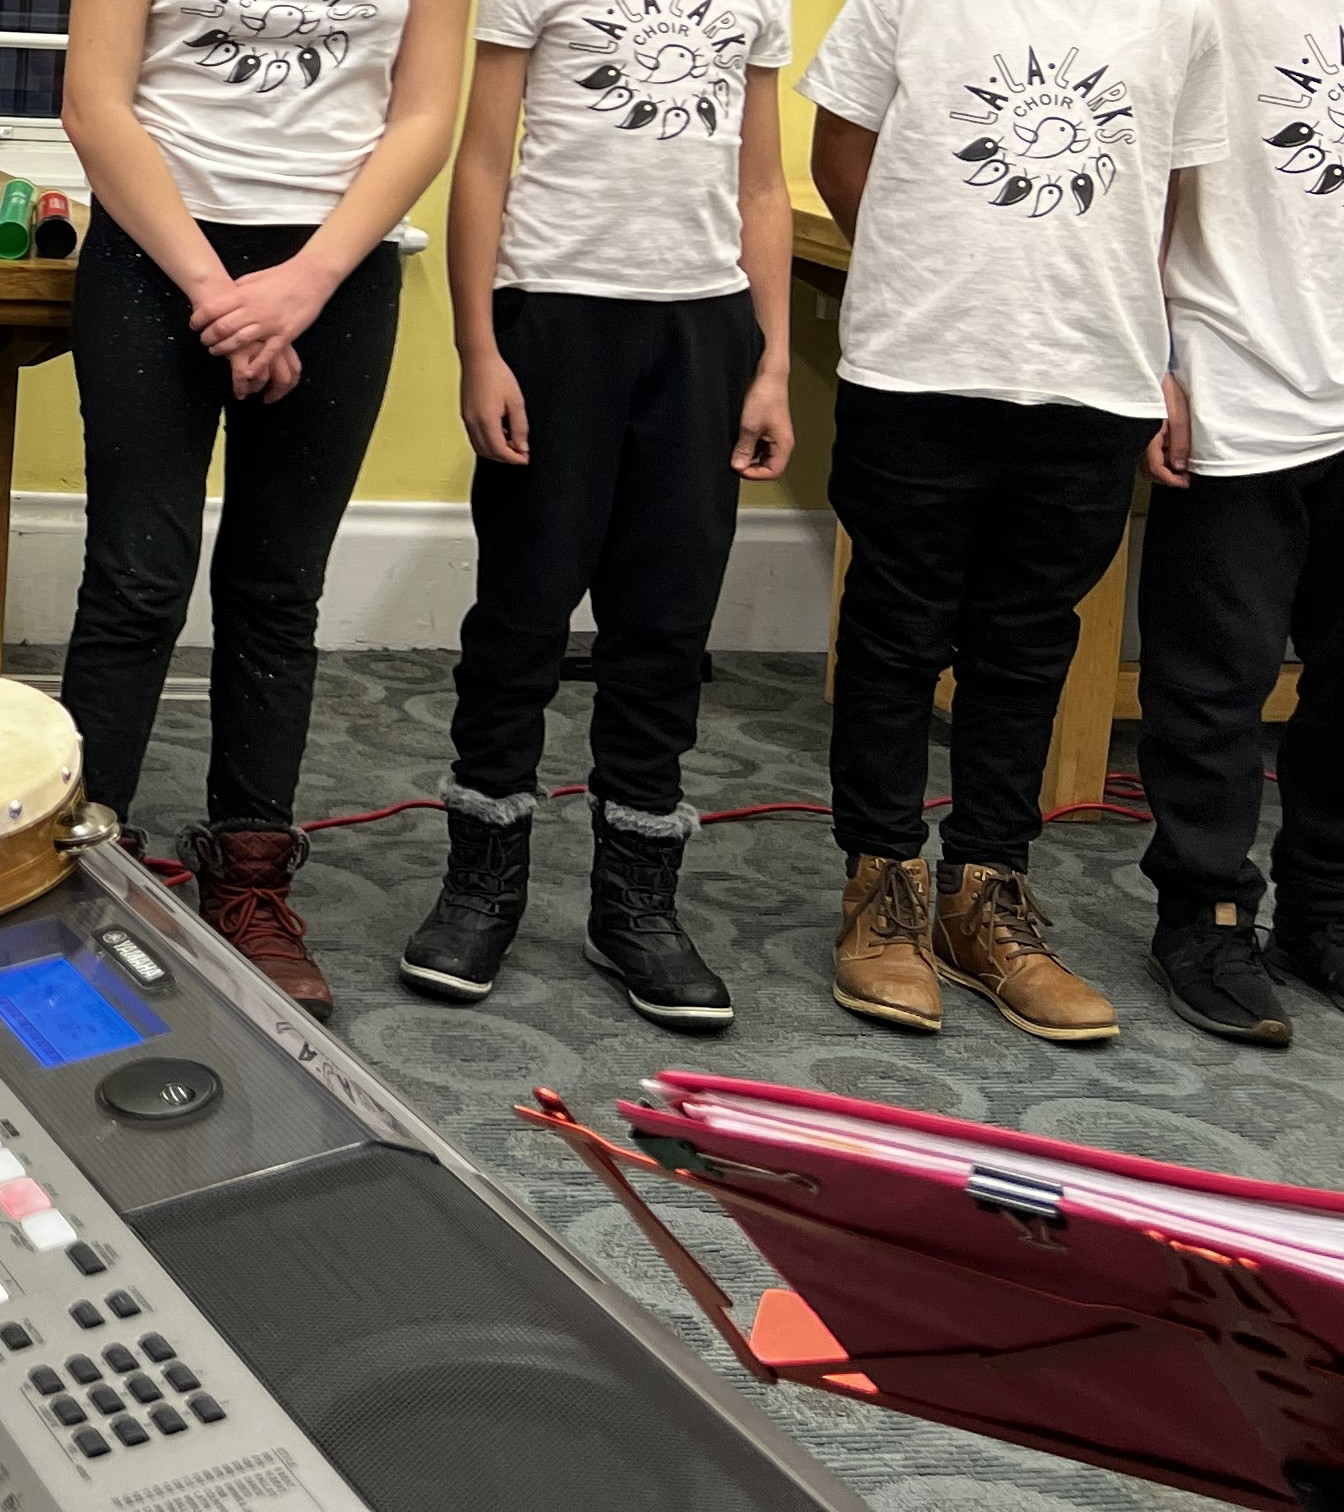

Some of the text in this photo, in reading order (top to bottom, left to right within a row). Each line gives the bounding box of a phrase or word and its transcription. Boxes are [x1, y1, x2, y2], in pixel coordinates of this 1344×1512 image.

[633, 22, 690, 46] CHOIR
[1013, 93, 1074, 119] CHOIR
[113, 939, 166, 982] YAMAHA
